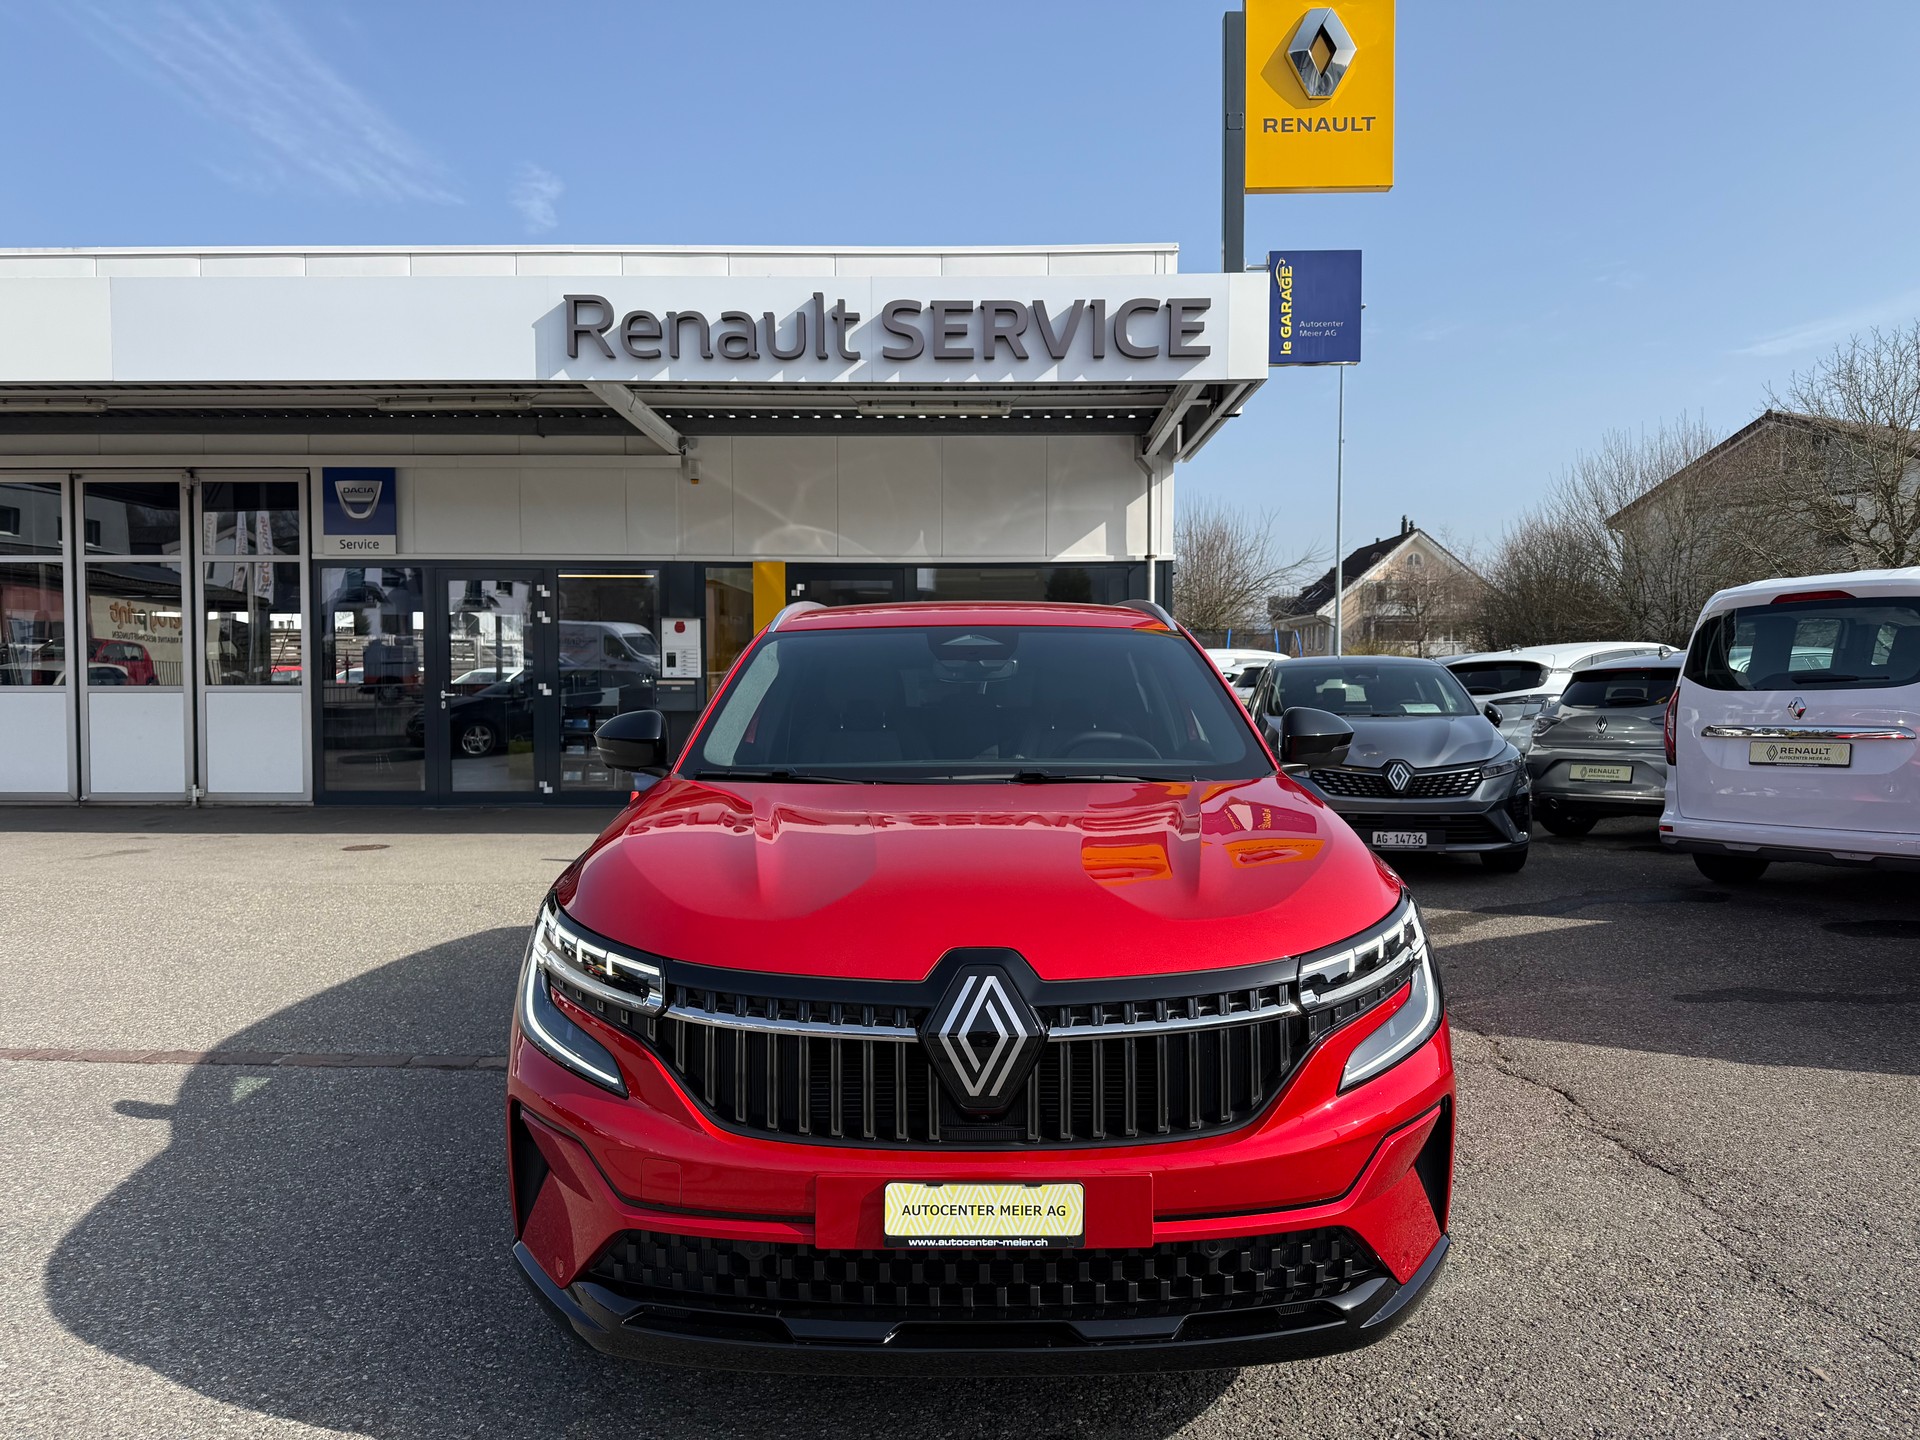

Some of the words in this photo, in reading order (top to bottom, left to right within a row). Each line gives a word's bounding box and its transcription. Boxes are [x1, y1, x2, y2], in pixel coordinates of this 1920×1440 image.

[1263, 116, 1376, 133] RENAULT
[1280, 265, 1293, 338] GARAGE
[563, 292, 862, 361] Renault
[881, 297, 1212, 360] SERVICE
[1325, 329, 1337, 337] AG
[1280, 341, 1292, 354] le
[339, 539, 380, 550] Service
[1780, 747, 1831, 755] RENAULT
[1376, 834, 1388, 844] AG
[1394, 834, 1424, 844] 14736
[902, 1204, 995, 1217] AUTOCENTER
[1000, 1204, 1042, 1217] MEIER
[1047, 1204, 1066, 1217] AG
[908, 1237, 1049, 1247] www.autocenter-meier.ch
